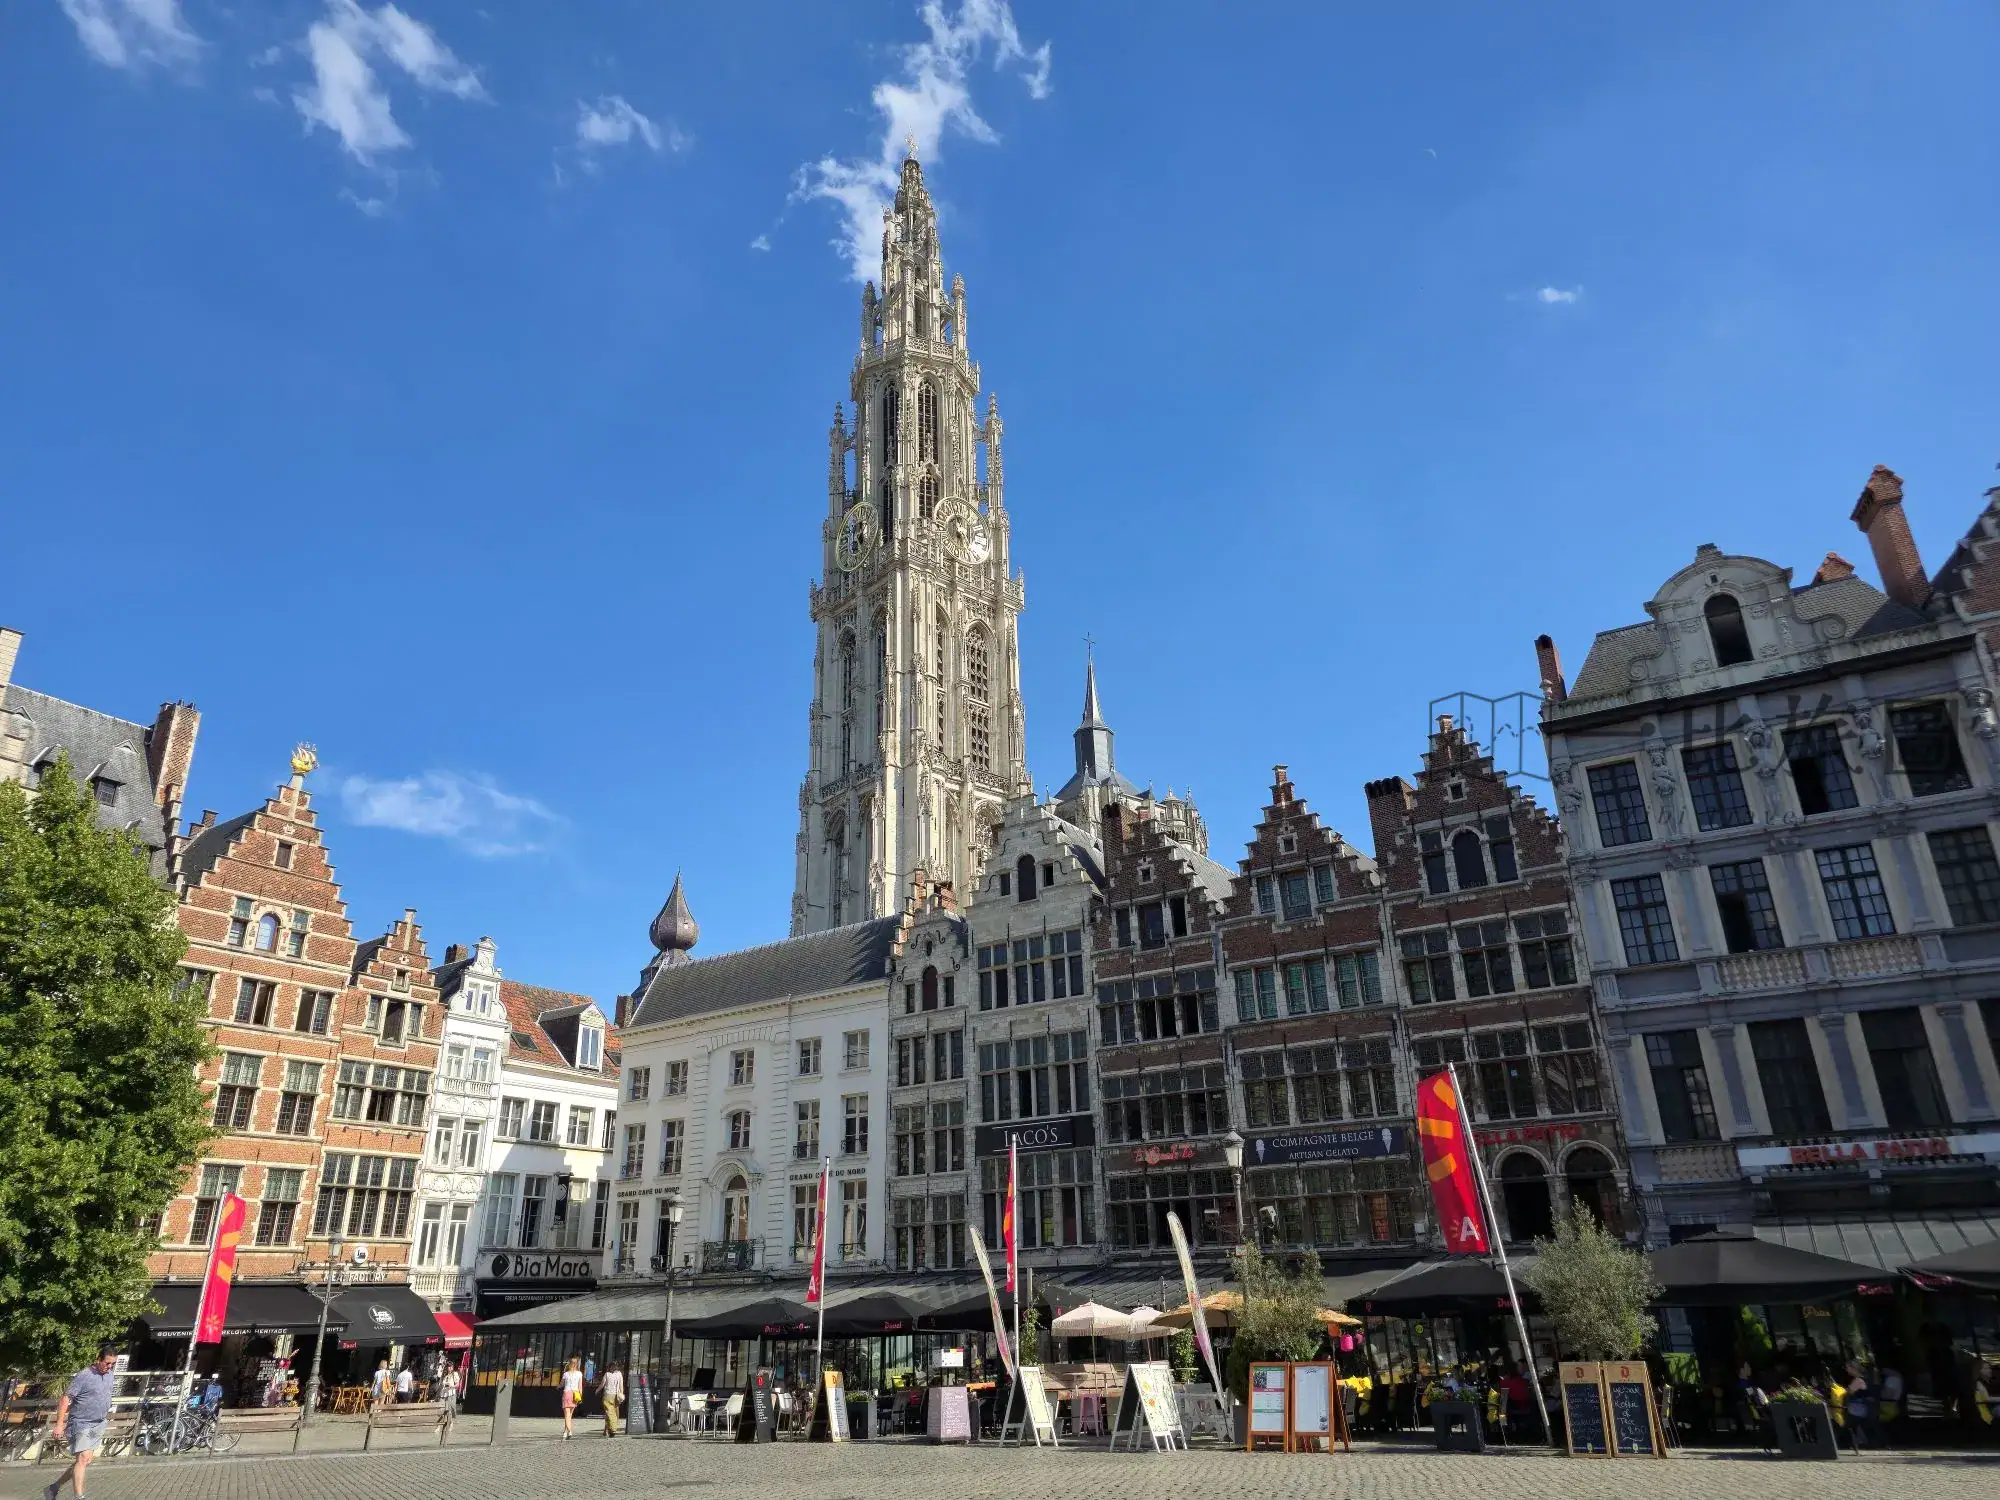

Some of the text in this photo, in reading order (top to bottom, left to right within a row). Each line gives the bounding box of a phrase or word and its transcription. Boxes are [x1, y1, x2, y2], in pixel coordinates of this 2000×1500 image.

[1272, 1130, 1375, 1148] COMPAGNIE BELGE
[1288, 1147, 1359, 1160] ARTISAN GELATO
[1789, 1137, 1951, 1164] BELLA PATIO
[789, 1173, 813, 1181] GRAND
[835, 1169, 845, 1177] DU
[846, 1167, 866, 1176] NORD
[616, 1190, 637, 1198] GRAND
[654, 1186, 663, 1194] DU
[664, 1185, 680, 1194] NORD
[1460, 1216, 1481, 1241] A
[513, 1254, 541, 1277] Bia
